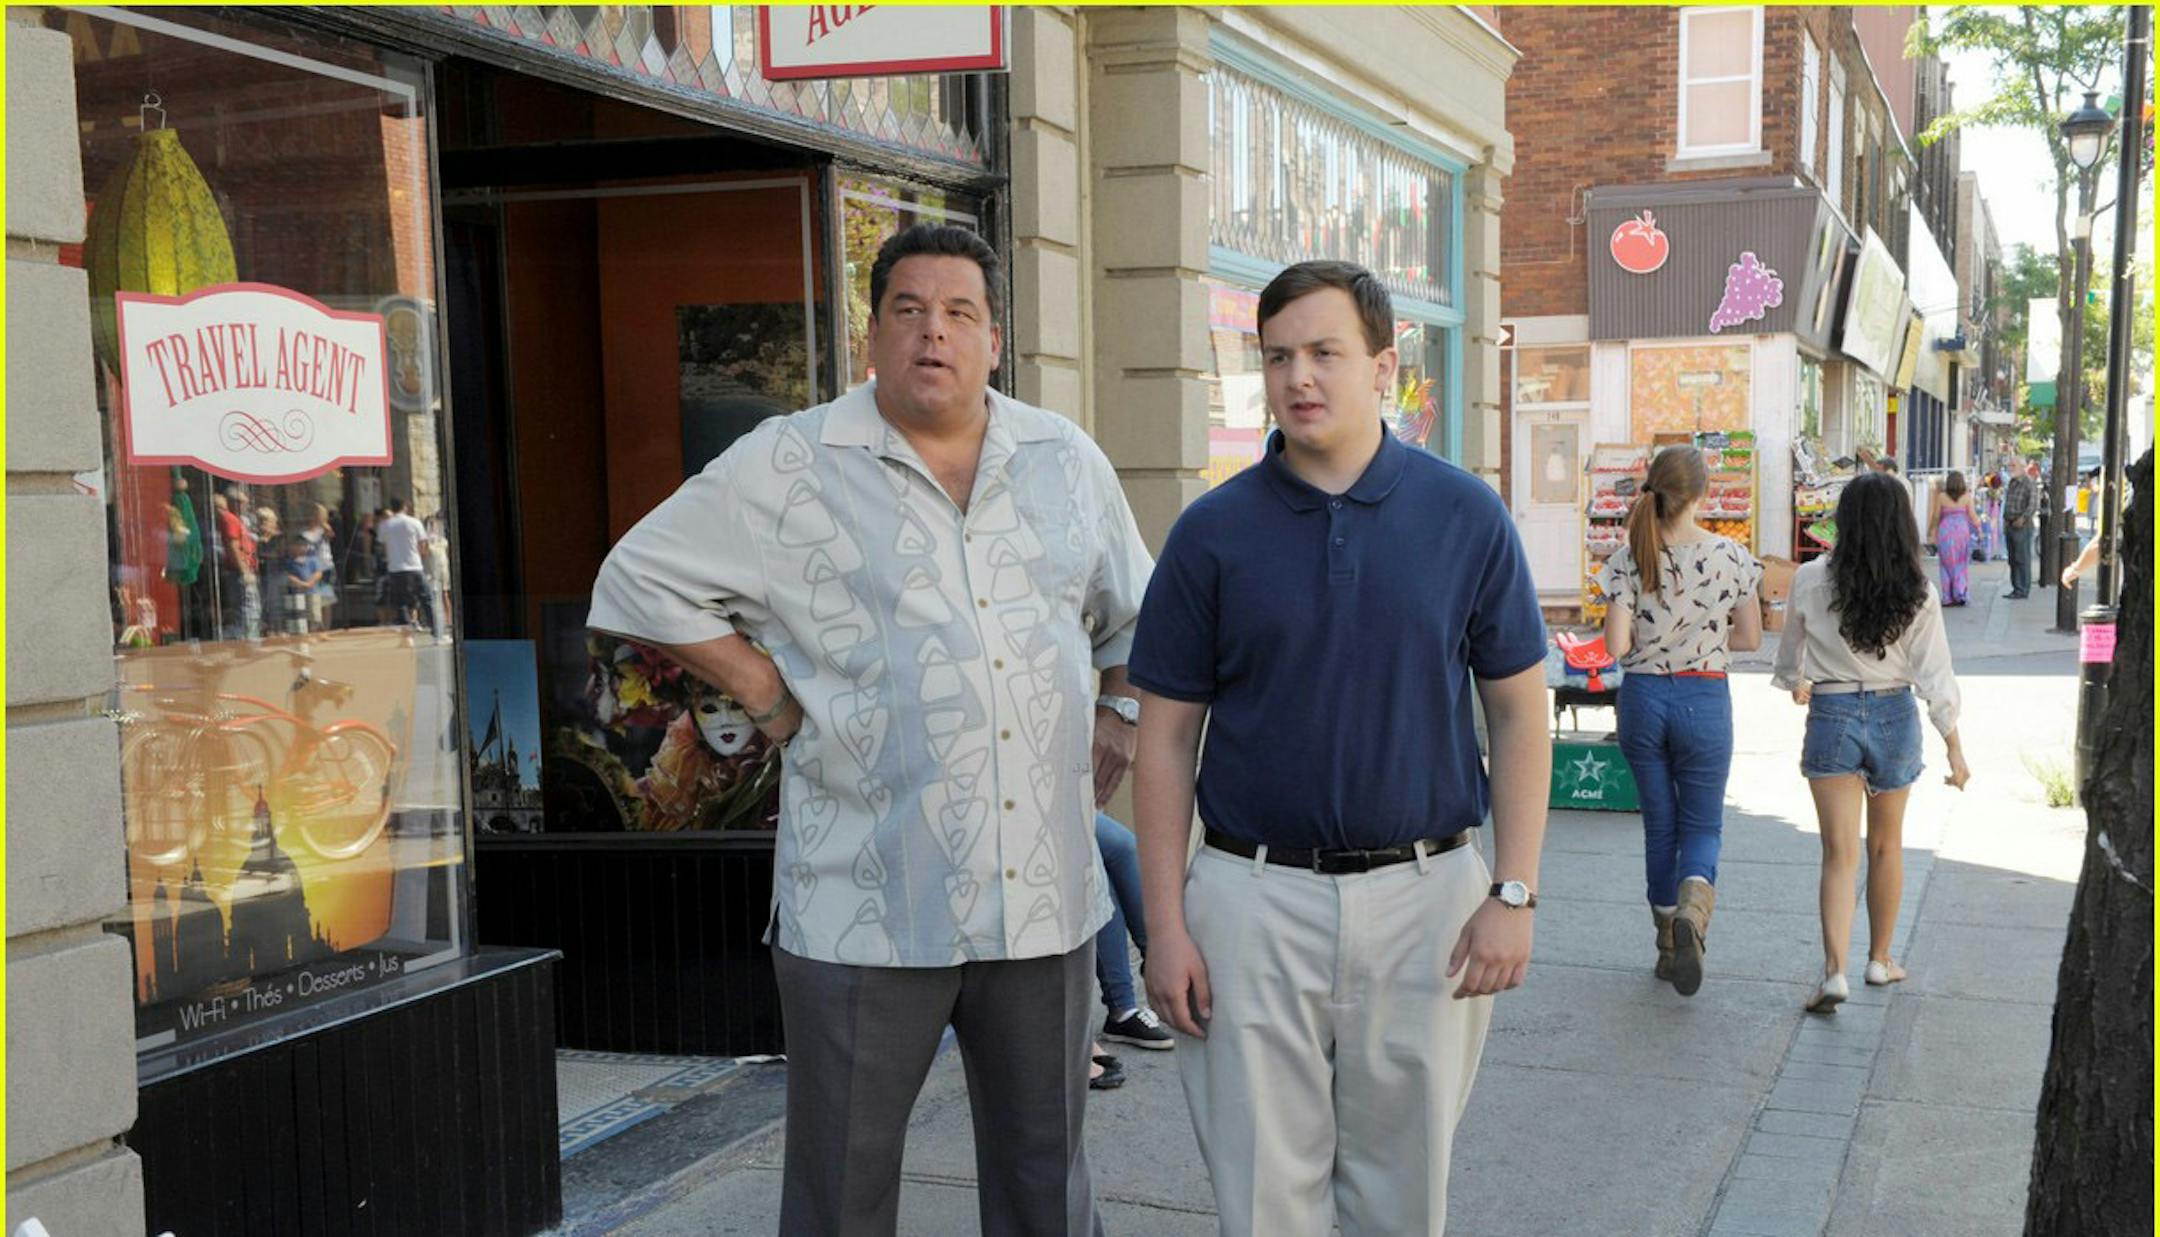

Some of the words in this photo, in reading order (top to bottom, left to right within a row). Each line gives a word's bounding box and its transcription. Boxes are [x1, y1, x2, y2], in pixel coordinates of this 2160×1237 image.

[145, 323, 267, 408] TRAVEL
[275, 326, 366, 415] AGENT
[179, 995, 227, 1031] Wi-Fi
[242, 983, 283, 1012] Thés
[298, 963, 365, 997] Desserts
[378, 951, 399, 978] Jus
